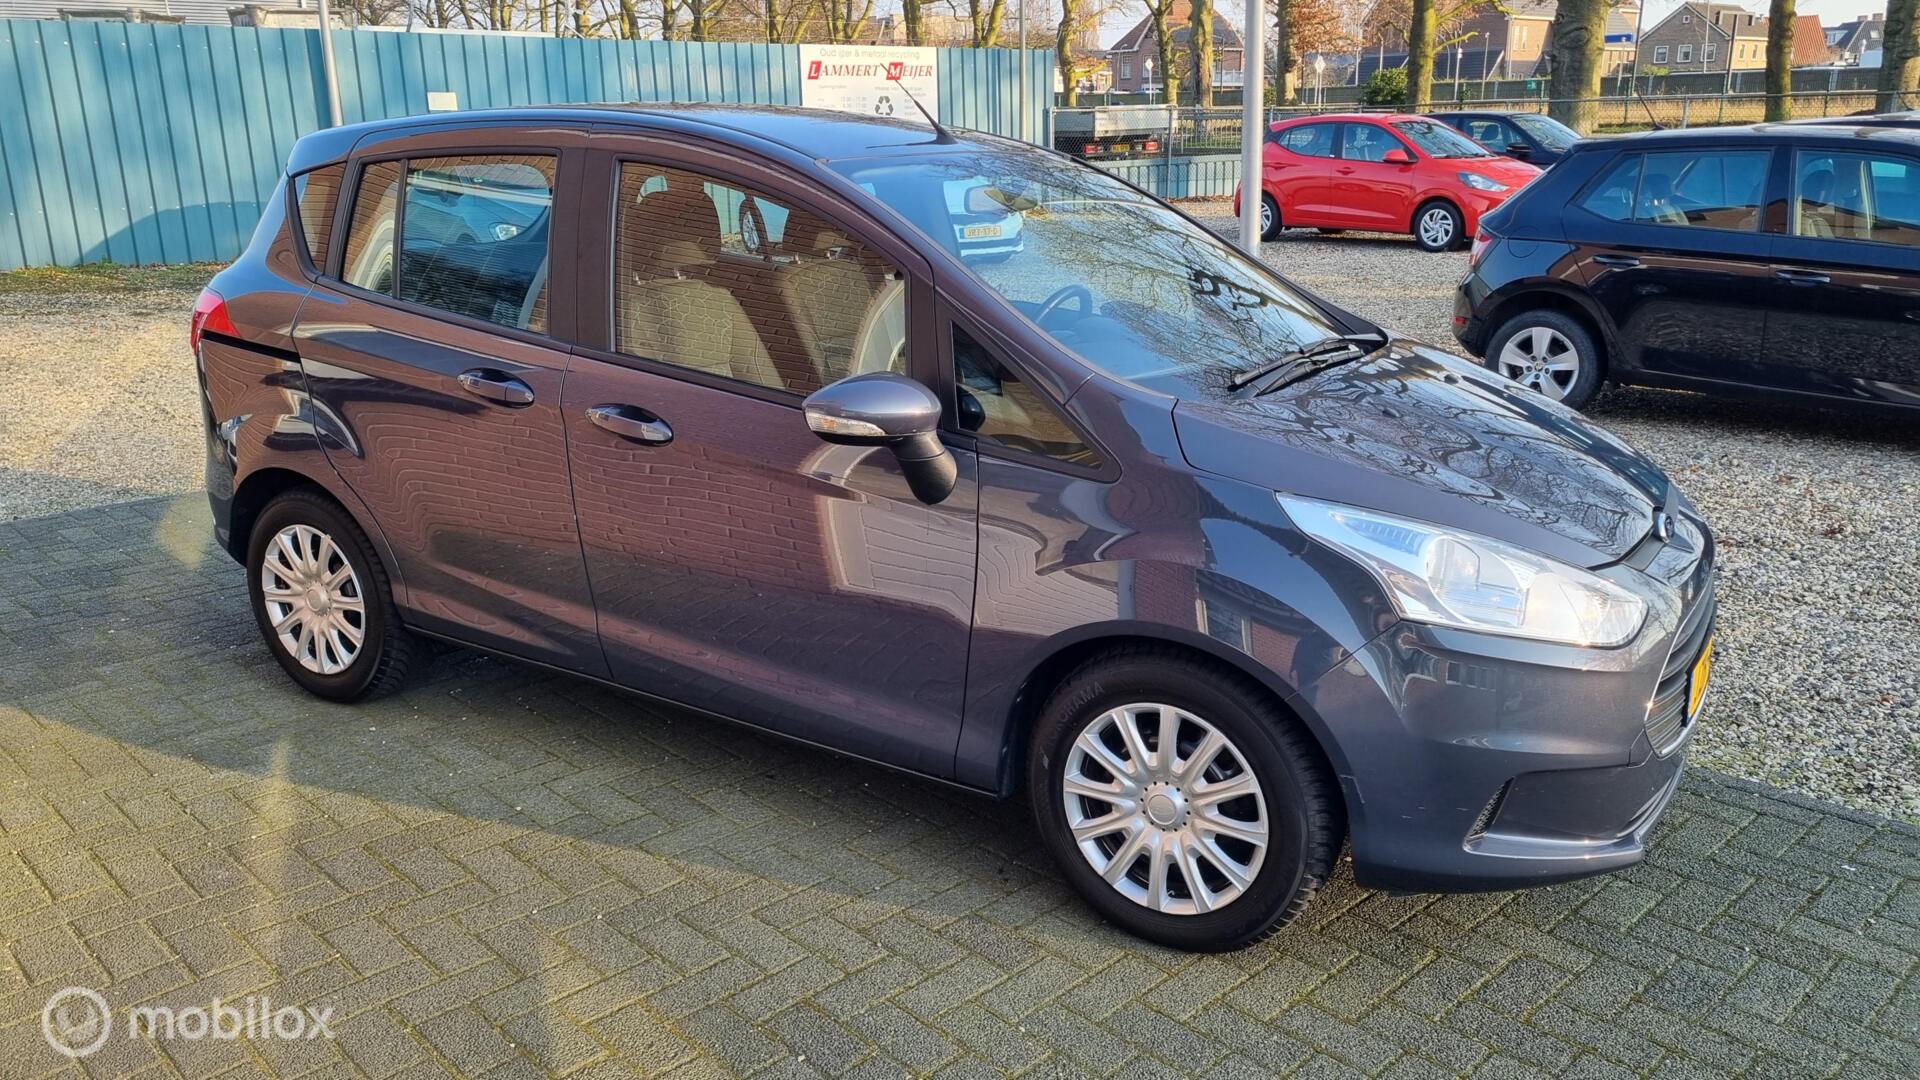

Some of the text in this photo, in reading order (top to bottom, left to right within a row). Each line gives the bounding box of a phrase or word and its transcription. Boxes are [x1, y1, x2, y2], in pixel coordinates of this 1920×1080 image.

[819, 48, 837, 57] Oud
[808, 62, 933, 80] LAMMERT MEIJER
